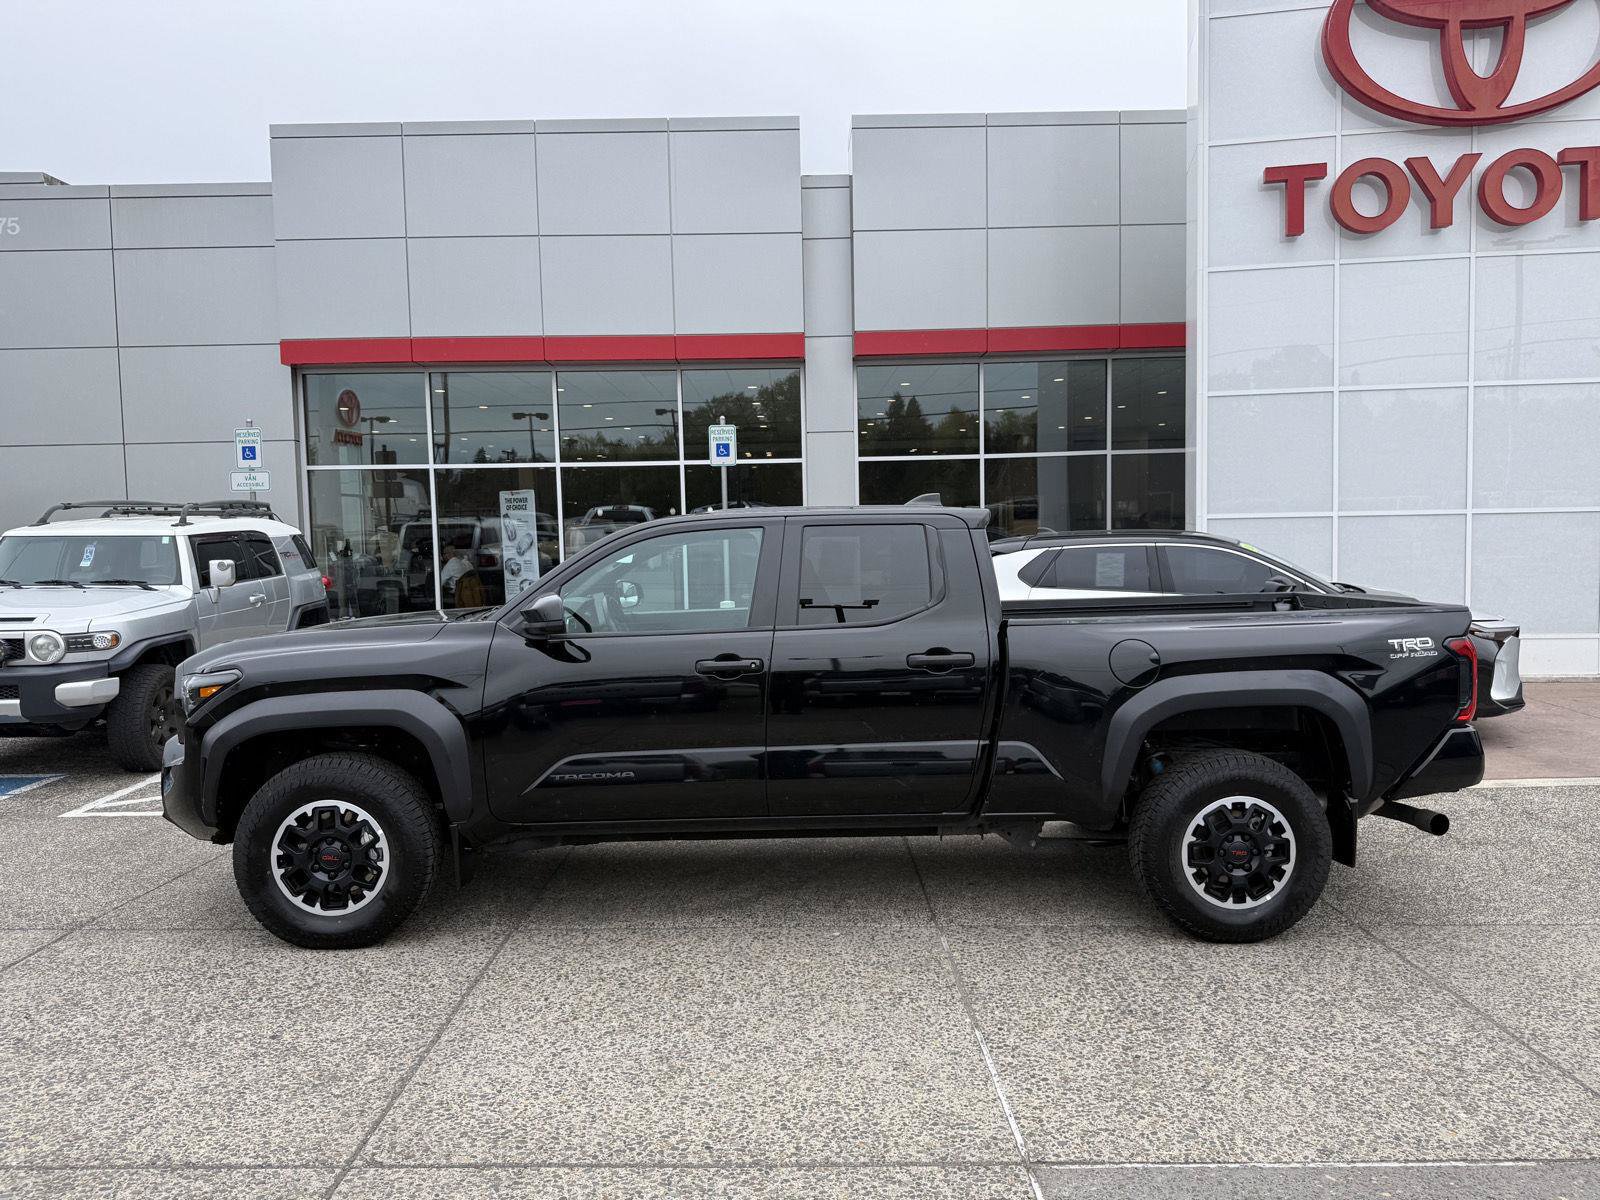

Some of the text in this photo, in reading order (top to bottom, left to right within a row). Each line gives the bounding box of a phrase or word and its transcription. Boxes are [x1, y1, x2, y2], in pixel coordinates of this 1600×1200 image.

[511, 503, 528, 511] CHOICE
[1387, 637, 1435, 652] TRD
[1410, 650, 1438, 658] ROAD
[550, 771, 635, 780] TACOMA
